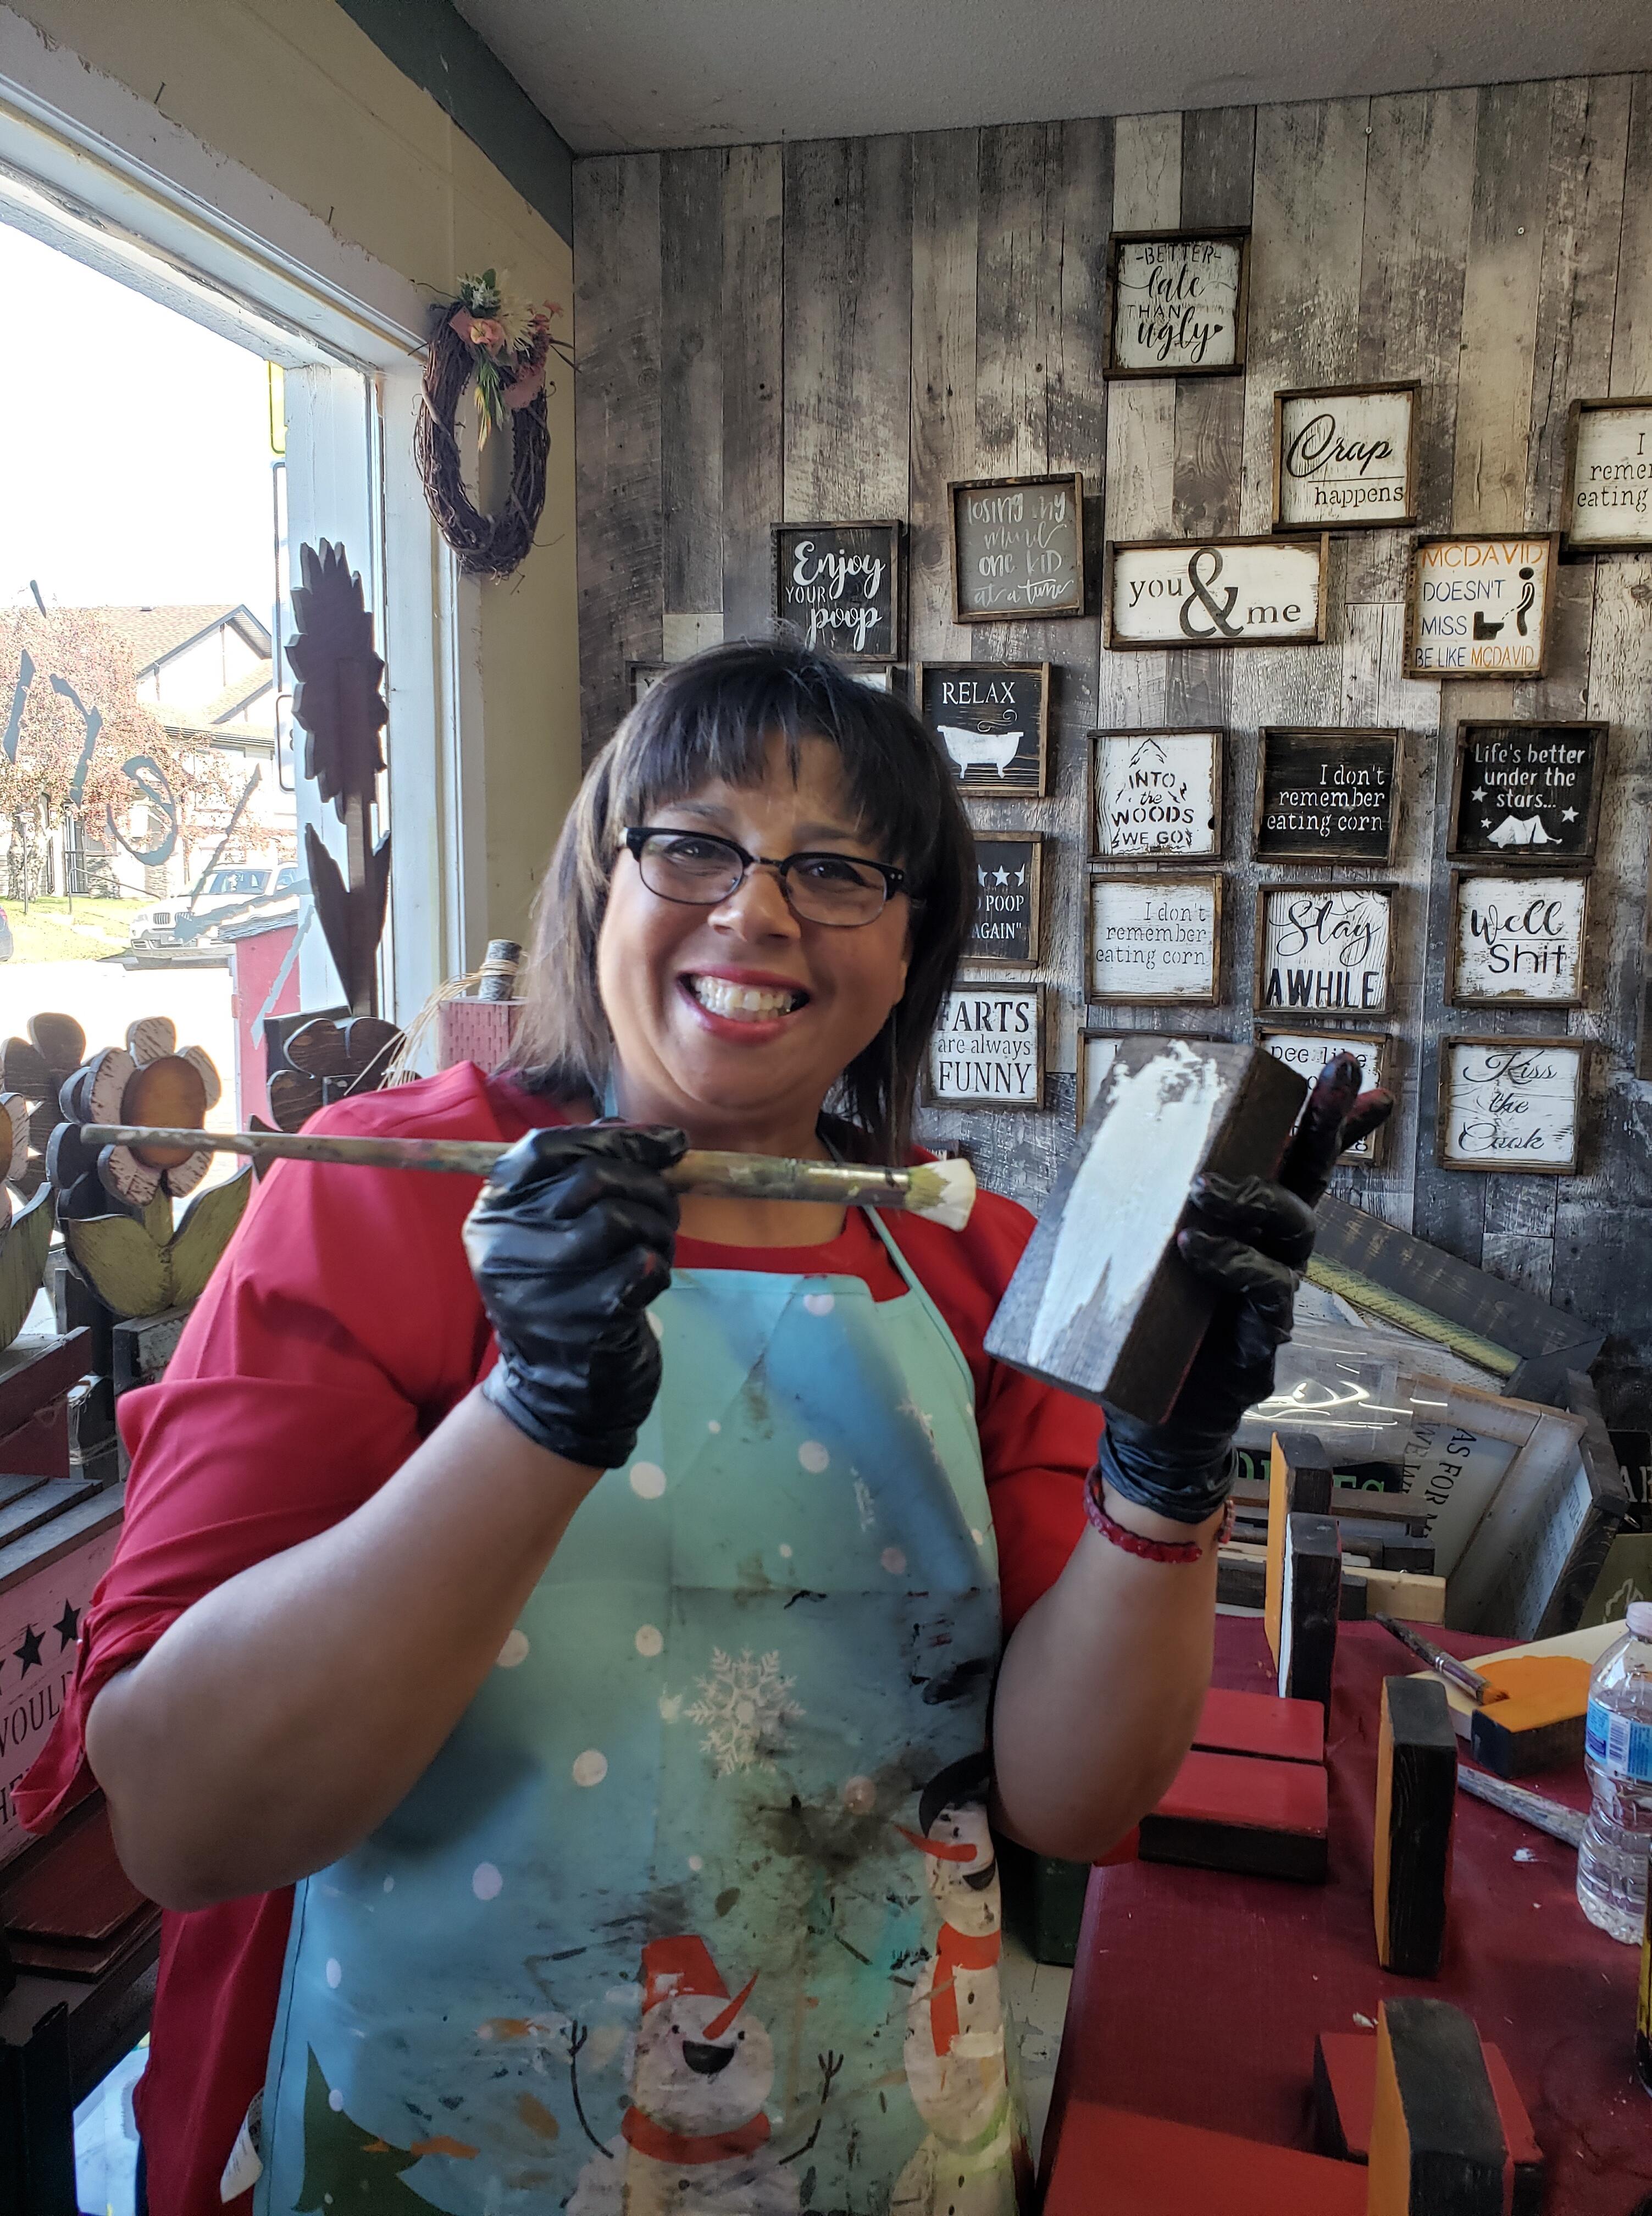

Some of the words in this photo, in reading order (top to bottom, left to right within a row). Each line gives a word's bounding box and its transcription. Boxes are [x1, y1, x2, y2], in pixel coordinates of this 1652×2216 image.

[1127, 304, 1181, 319] THAN
[1138, 306, 1211, 363] ugly
[1287, 414, 1393, 478] Crap
[1636, 433, 1645, 455] I
[1589, 463, 1652, 481] reme
[1314, 486, 1404, 508] happens
[1577, 486, 1649, 512] eating
[979, 553, 1015, 577] one
[1421, 543, 1543, 568] MCDAVID
[793, 540, 886, 600] Enjoy
[785, 586, 826, 603] YOUR
[1007, 589, 1021, 603] a
[1129, 578, 1183, 608] you
[1179, 547, 1244, 638] &
[1246, 604, 1301, 625] me
[1423, 579, 1506, 601] DOESN'T
[805, 607, 883, 652] poop
[1422, 616, 1467, 636] MISS
[1415, 647, 1433, 668] BE
[1438, 647, 1467, 667] LIKE
[1471, 646, 1534, 668] MCDAVID
[942, 682, 1016, 705] RELAX
[1475, 743, 1521, 763] Life's
[1528, 743, 1586, 764] better
[1129, 769, 1176, 789] INTO
[1320, 764, 1328, 785] I
[1334, 764, 1385, 785] don't
[1484, 767, 1538, 786] under
[1544, 767, 1576, 786] the
[1140, 791, 1163, 806] the
[1278, 787, 1385, 807] remember
[1111, 806, 1195, 827] WOODS
[1267, 811, 1332, 837] eating
[1338, 815, 1383, 831] corn
[1122, 832, 1149, 845] WE
[1156, 830, 1183, 844] GO
[986, 895, 1024, 912] POOP
[1143, 902, 1152, 921] I
[1158, 902, 1206, 922] don't
[1106, 923, 1206, 942] remember
[1271, 900, 1381, 967] Stay
[1096, 945, 1156, 970] eating
[1163, 950, 1206, 965] corn
[1488, 944, 1566, 973] Shit
[1266, 968, 1380, 1009] AWHILE
[936, 1000, 1029, 1033] FARTS
[938, 1038, 965, 1054] are
[971, 1034, 1030, 1061] always
[939, 1061, 1032, 1094] FUNNY
[1462, 1050, 1557, 1085] Kiss
[1488, 1093, 1529, 1114] the
[1447, 1428, 1477, 1457] AS
[1424, 1462, 1462, 1505] FOR
